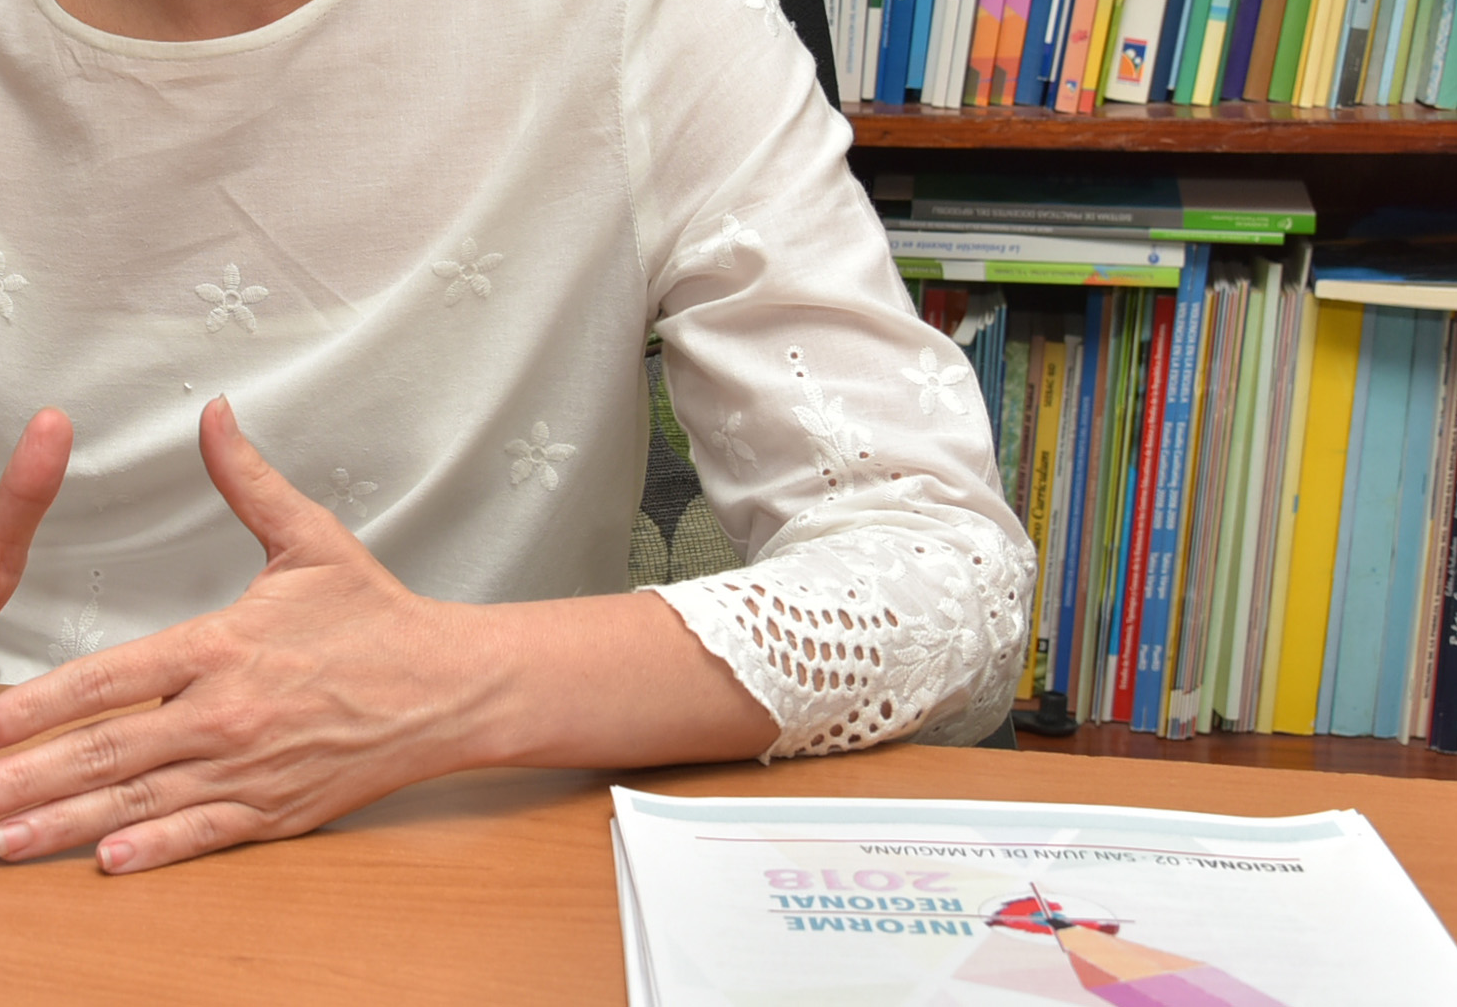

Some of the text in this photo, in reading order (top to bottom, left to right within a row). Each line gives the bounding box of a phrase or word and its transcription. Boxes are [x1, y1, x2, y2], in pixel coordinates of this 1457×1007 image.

[976, 208, 990, 216] DEL
[994, 209, 1034, 217] DOCENTES
[1036, 210, 1081, 221] PRÁCTICAS
[1084, 212, 1094, 220] DE
[1096, 212, 1132, 221] SISTEMA
[901, 240, 1020, 253] La Evaluación Docente en
[1166, 301, 1187, 403] VIOLENCIA EN LA ESCUELA
[1179, 301, 1200, 403] VIOLENCIA EN LA ESCUELA
[1161, 421, 1174, 448] Estudio
[1174, 421, 1187, 448] Estudio
[1119, 667, 1129, 689] Estudio
[858, 843, 1304, 874] REGIONAL: 02 SAN JUAN DE LA MAGUANA
[763, 868, 957, 892] 2018
[769, 894, 963, 912] REGIONAL
[783, 913, 973, 937] INFORME
